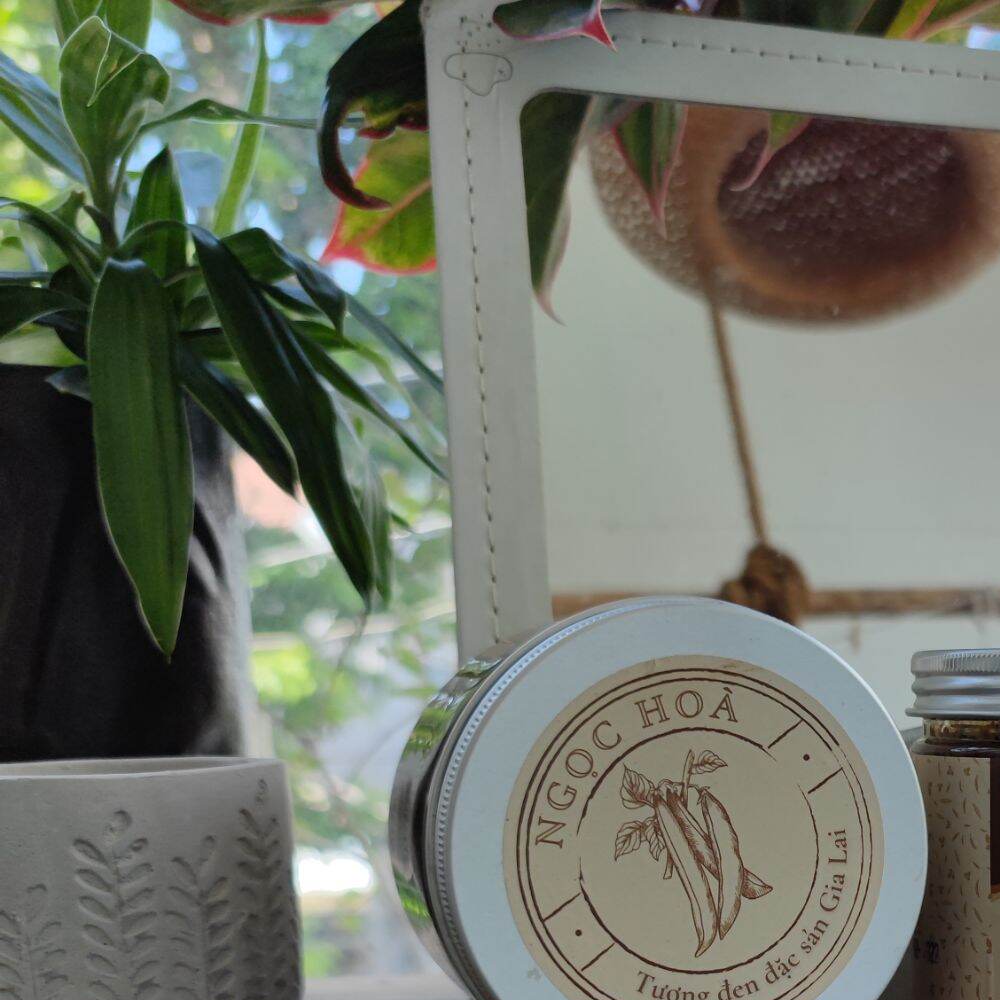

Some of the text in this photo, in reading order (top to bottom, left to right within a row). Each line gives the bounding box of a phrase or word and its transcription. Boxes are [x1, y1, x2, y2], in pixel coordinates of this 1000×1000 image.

[535, 687, 739, 848] NGỌC HOÀ
[827, 827, 848, 867] Lai
[819, 870, 847, 913] Gia
[799, 919, 830, 955] sản
[763, 952, 800, 985] đặc
